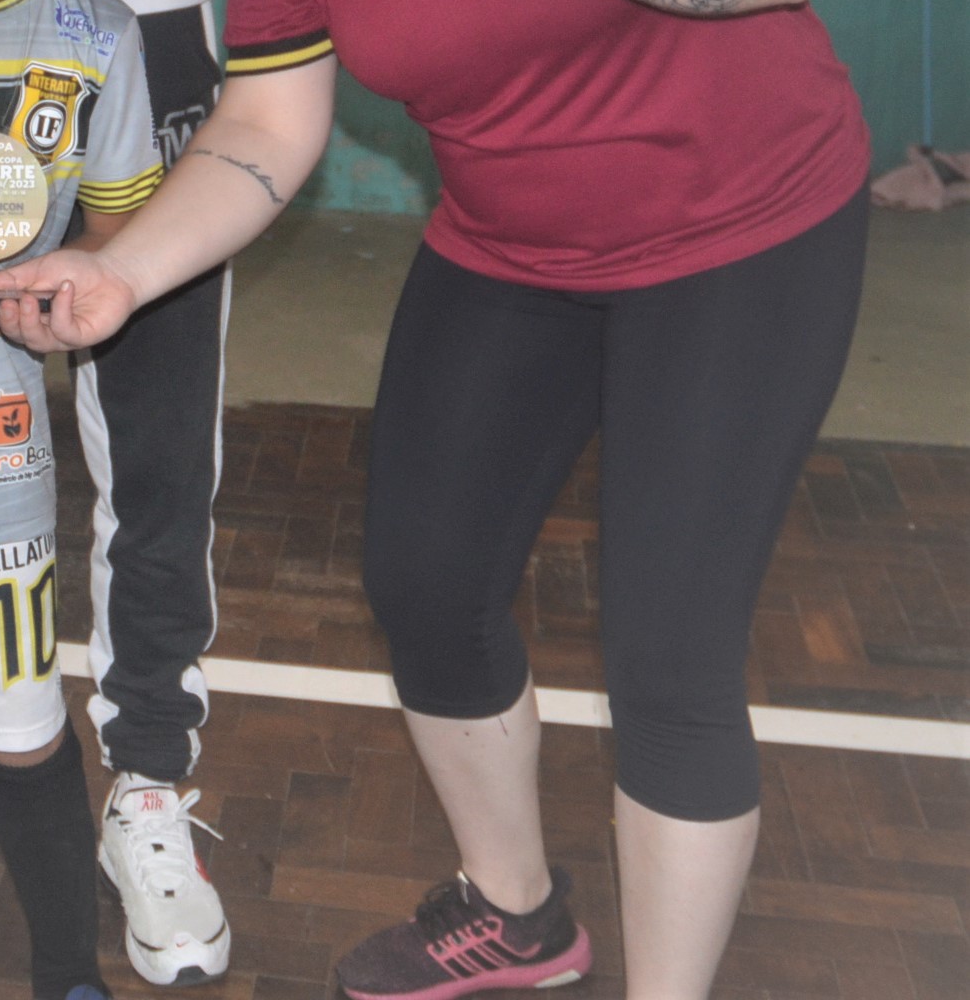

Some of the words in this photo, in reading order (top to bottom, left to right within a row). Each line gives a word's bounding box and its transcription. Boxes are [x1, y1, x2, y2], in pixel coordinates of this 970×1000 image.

[34, 113, 63, 140] IF
[9, 180, 36, 189] 2023
[141, 799, 164, 811] AIR
